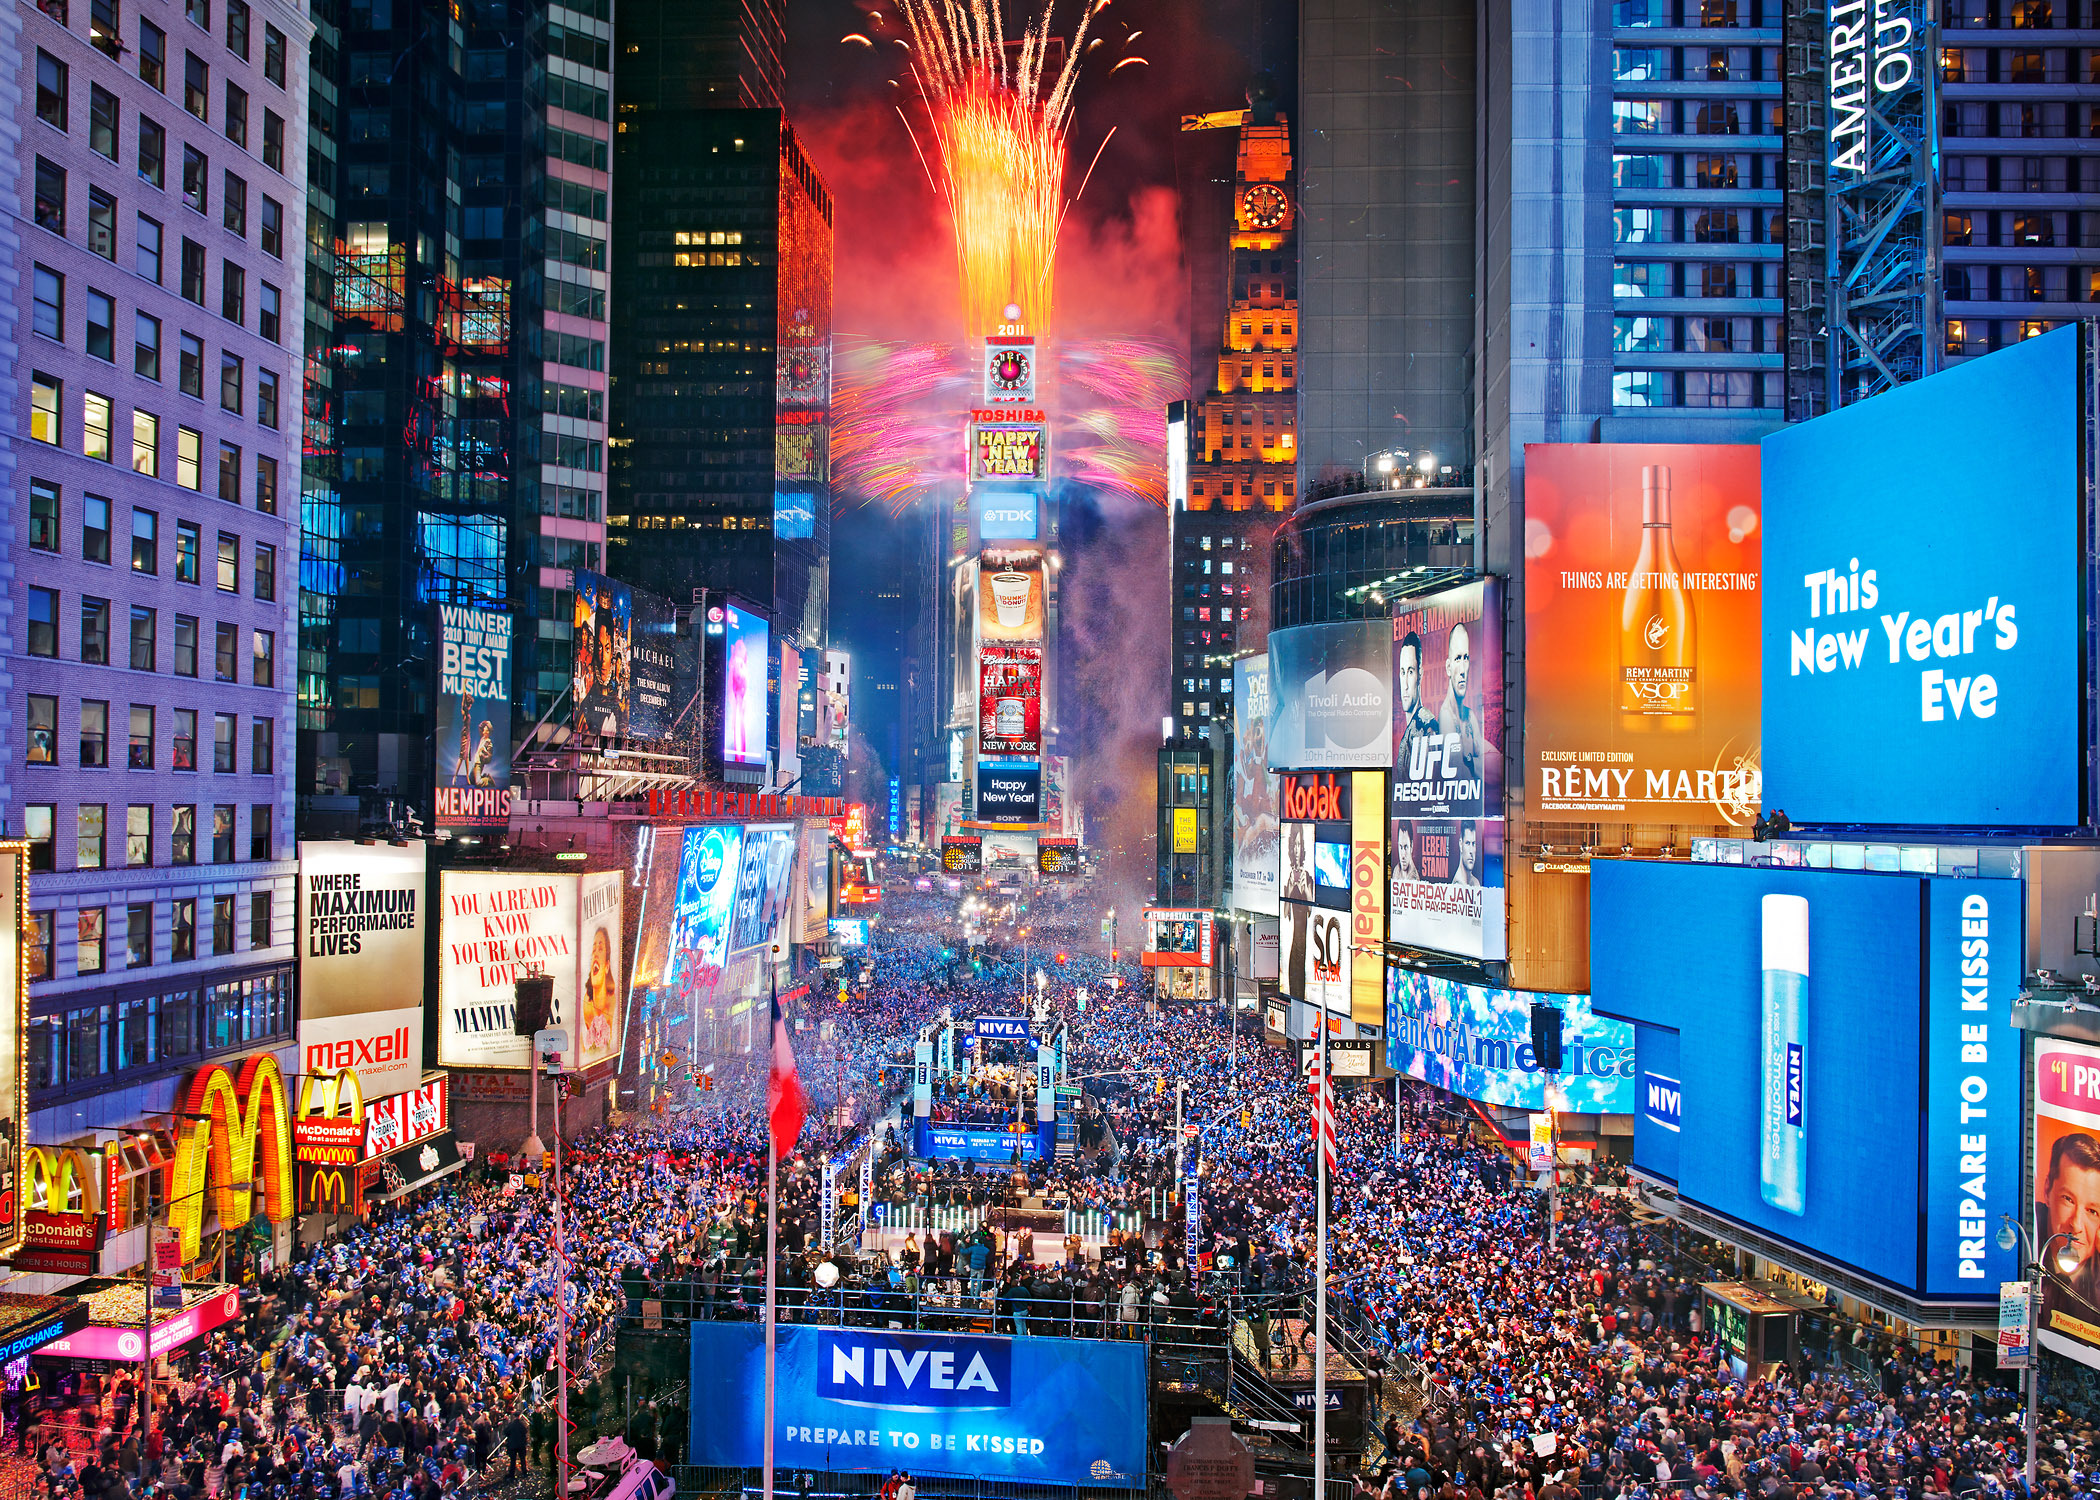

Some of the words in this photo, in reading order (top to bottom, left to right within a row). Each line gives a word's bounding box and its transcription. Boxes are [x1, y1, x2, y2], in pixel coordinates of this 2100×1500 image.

[998, 324, 1025, 336] 2011
[986, 336, 1034, 346] TOSHIBA
[971, 409, 1047, 422] TOSHIBA
[979, 431, 1040, 446] HAPPY
[988, 445, 1030, 460] NEW
[983, 459, 1034, 474] YEAR!
[995, 510, 1032, 522] TDK
[1560, 571, 1602, 589] THINGS
[1606, 571, 1628, 589] ARE
[1631, 572, 1679, 590] GETTING
[1804, 557, 1879, 618] This
[440, 605, 511, 636] WINNER!
[708, 623, 723, 634] LG
[1393, 610, 1424, 642] EDGAR
[1427, 597, 1481, 633] MAYNARD
[444, 626, 462, 642] 2010
[464, 629, 483, 646] TONY
[484, 633, 509, 650] AWARD
[1791, 627, 1870, 677] New
[1880, 596, 2018, 664] Year's
[443, 642, 508, 681] BEST
[633, 646, 675, 669] MICHAEL
[982, 654, 1040, 665] Budweiser
[983, 676, 1036, 687] HAPPY
[1626, 666, 1652, 678] RÉMY
[1654, 668, 1690, 678] MARTIN
[442, 674, 507, 700] MUSICAL
[637, 678, 647, 689] THE
[646, 680, 657, 690] NEW
[984, 687, 1007, 696] NEW
[1009, 687, 1037, 697] YEAR
[1247, 674, 1269, 698] YOGI
[1626, 682, 1689, 699] VSOP
[640, 693, 663, 707] DECEMBER
[1308, 694, 1338, 707] Tivoli
[1342, 693, 1382, 707] Audio
[1921, 669, 1998, 722] Eve
[1316, 710, 1336, 718] Original
[1337, 709, 1353, 717] Radio
[1353, 709, 1383, 718] Company
[982, 741, 1007, 750] NEW
[1008, 741, 1037, 751] YORK
[1304, 750, 1323, 762] 10th
[1325, 750, 1390, 764] Anniversary
[1409, 732, 1461, 782] UFC
[1541, 751, 1577, 762] EXCLUSIVE
[1578, 751, 1606, 762] LIMITED
[1606, 752, 1634, 763] EDITION
[992, 779, 1027, 791] Happy
[1394, 779, 1482, 802] RESOLUTION
[1540, 765, 1635, 798] RÉMY
[435, 787, 511, 816] MEMPHIS
[983, 791, 1007, 802] New
[1008, 792, 1035, 803] Year!
[1284, 773, 1343, 820] Kodak
[1541, 803, 1625, 811] FACEBOOK.COM/REMYMARTIN
[942, 836, 981, 844] TOSHIBA
[1177, 825, 1194, 836] LION
[745, 841, 769, 863] HAPPY
[1039, 838, 1077, 846] TOSHIBA
[1176, 837, 1194, 847] KING
[1421, 836, 1447, 857] LEBEN
[1421, 856, 1449, 878] STANN
[310, 873, 361, 892] WHERE
[742, 870, 760, 890] NEW
[451, 893, 482, 916] YOU
[488, 885, 558, 913] ALREADY
[1355, 841, 1380, 960] Kodak
[1392, 881, 1448, 901] SATURDAY
[310, 889, 416, 917] MAXIMUM
[583, 887, 606, 921] MAMMA
[739, 896, 757, 918] YEAR
[1392, 896, 1409, 909] LIVE
[1411, 898, 1423, 911] ON
[309, 913, 415, 935] PERFORMANCE
[483, 913, 531, 938] KNOW
[309, 932, 362, 958] LIVES
[452, 939, 510, 965] YOU'RE
[514, 934, 570, 960] GONNA
[1313, 914, 1341, 967] SO
[1961, 893, 1990, 1011] KISSED
[480, 961, 519, 988] LOVE
[453, 1003, 517, 1034] MAMMA
[979, 1022, 1026, 1035] NIVEA
[306, 1026, 409, 1073] maxell
[1302, 1041, 1371, 1049] MQUIS
[1388, 1002, 1430, 1052] Bank
[1432, 1020, 1456, 1058] of
[1453, 1021, 1636, 1079] Ameica
[1773, 1034, 1780, 1049] OF
[1961, 1023, 1989, 1063] BE
[919, 1062, 927, 1084] NIVEA
[1790, 1050, 1800, 1120] NIVEA
[1772, 1053, 1783, 1160] Smoothness
[1960, 1075, 1988, 1124] TO
[297, 1125, 361, 1137] McDonald's
[307, 1135, 350, 1143] Restaurant
[375, 1122, 396, 1138] FRIDAYS
[934, 1135, 966, 1146] NIVEA
[1959, 1134, 1987, 1279] PREPARE
[25, 1223, 94, 1239] cDonald's
[26, 1236, 80, 1246] Restaurant
[16, 1258, 41, 1266] OPEN
[43, 1258, 54, 1267] 24
[56, 1259, 88, 1270] HOURS
[12, 1321, 64, 1355] EXCHANGE
[150, 1328, 168, 1342] TIMES
[168, 1315, 191, 1335] SQUARE
[150, 1336, 172, 1354] VISITOR
[172, 1325, 194, 1343] CENTER
[833, 1343, 1000, 1392] NIVEA
[787, 1425, 880, 1447] PREPARE
[889, 1431, 920, 1450] TO
[930, 1434, 956, 1452] BE
[966, 1434, 1046, 1455] KISSED
